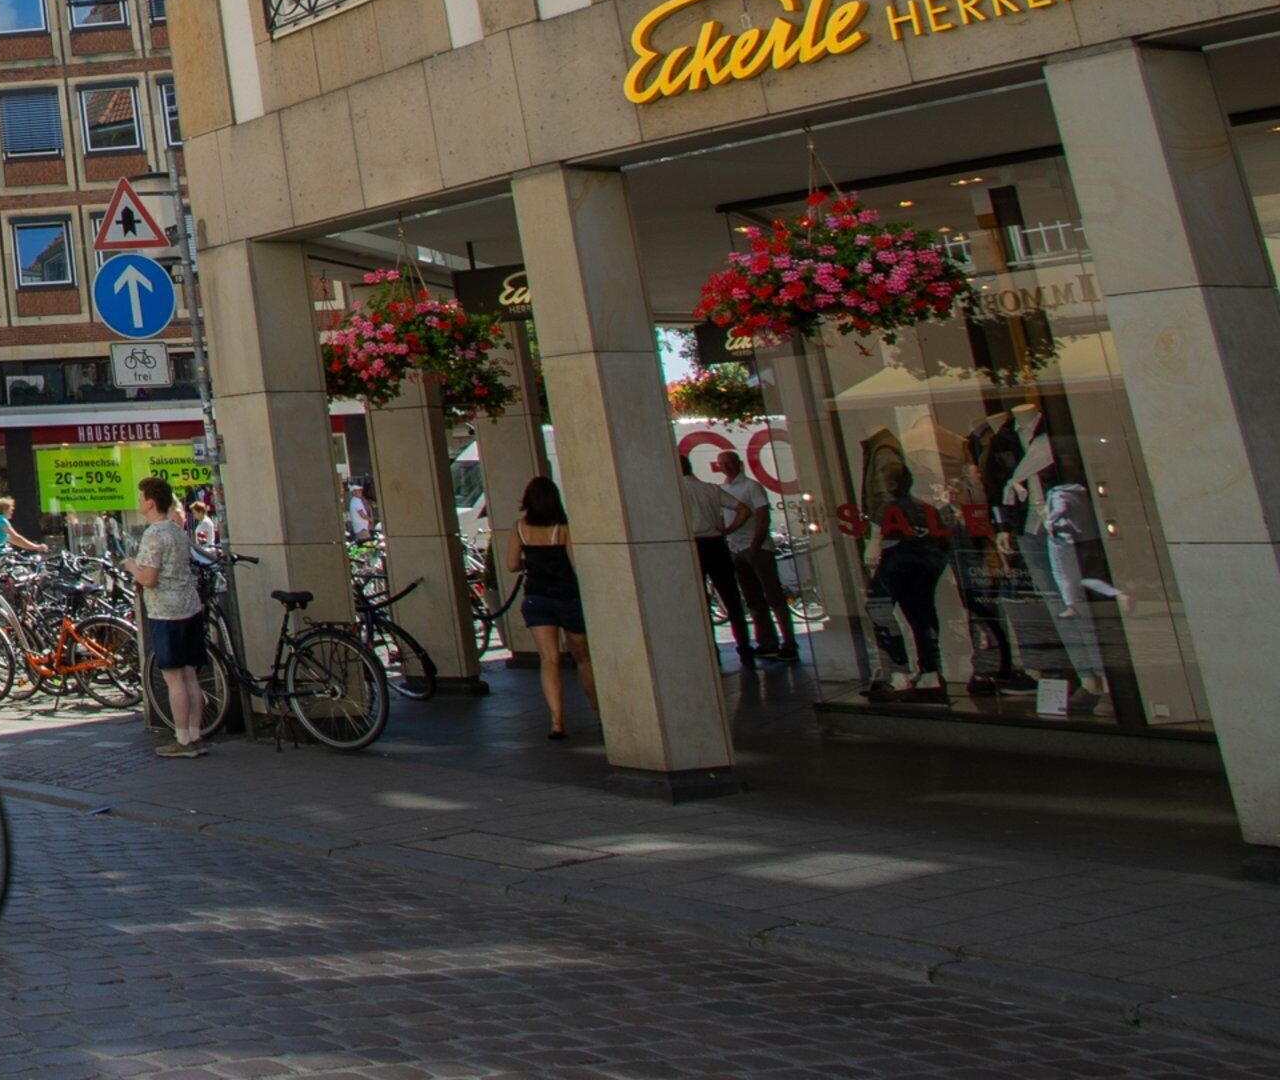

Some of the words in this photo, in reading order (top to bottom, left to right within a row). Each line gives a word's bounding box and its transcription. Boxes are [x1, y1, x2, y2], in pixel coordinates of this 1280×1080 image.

[133, 371, 152, 381] frei
[77, 423, 161, 442] HAUSFELDER
[836, 502, 995, 538] SALE
